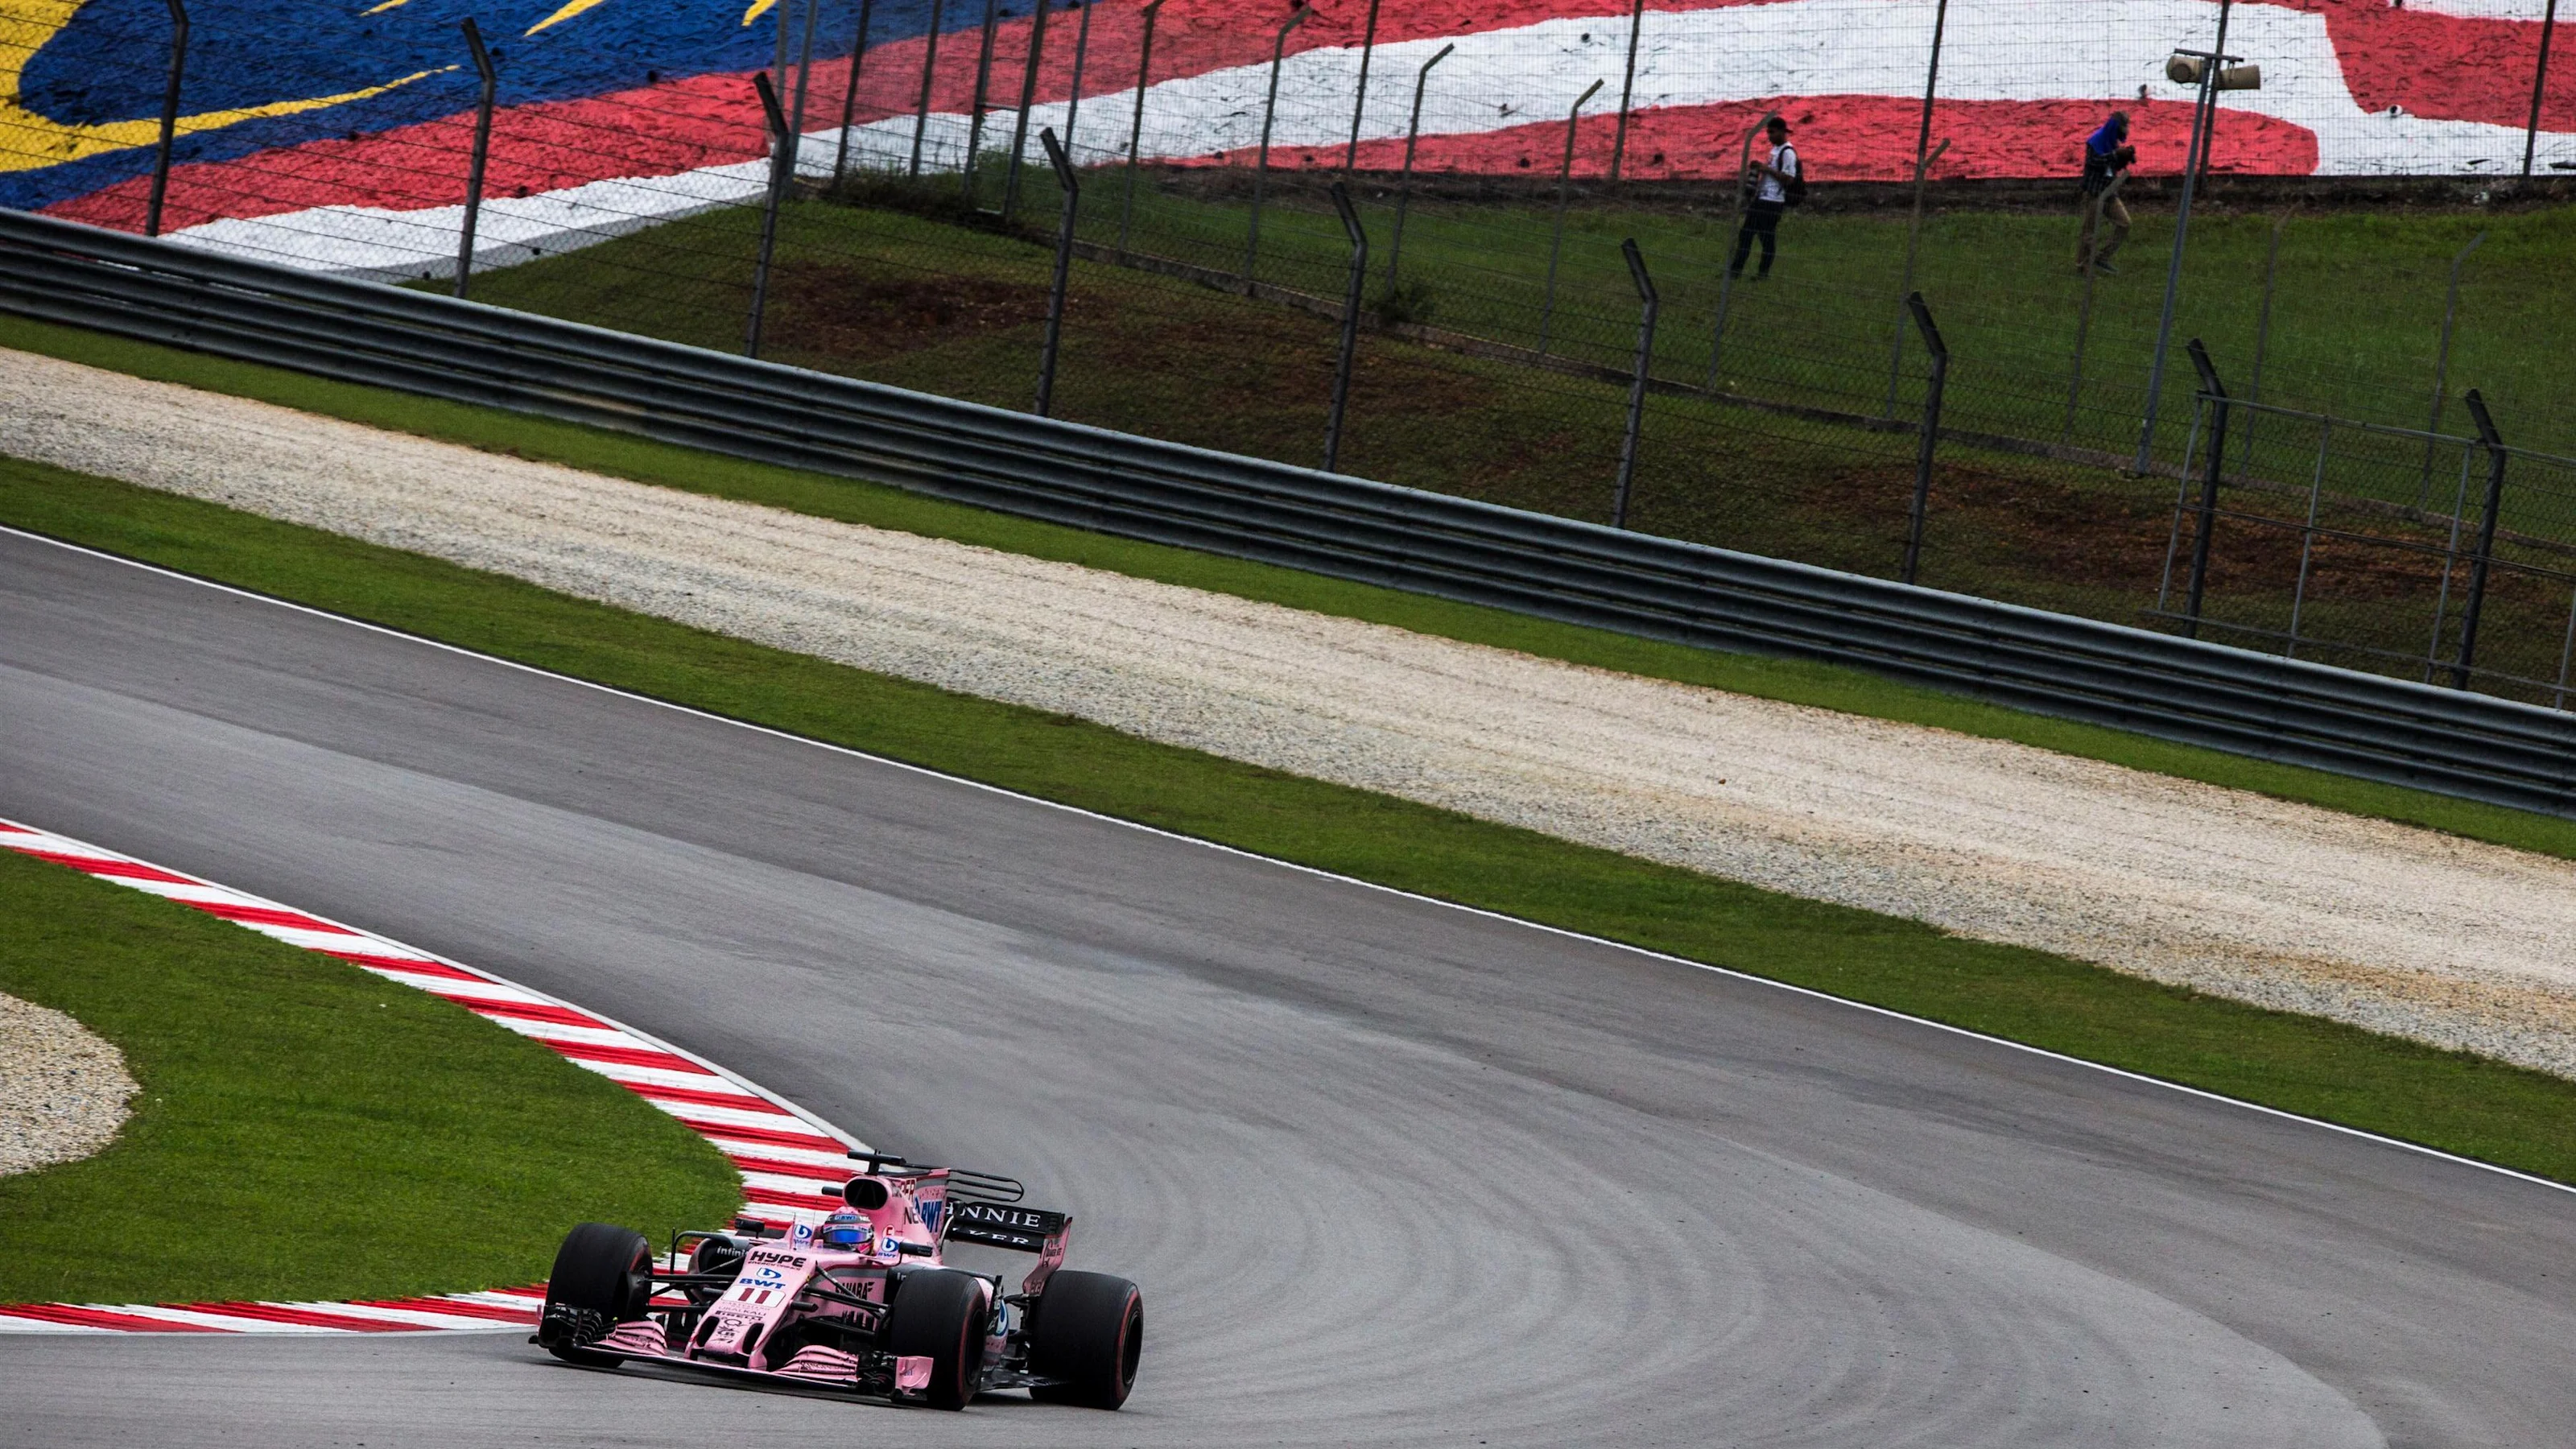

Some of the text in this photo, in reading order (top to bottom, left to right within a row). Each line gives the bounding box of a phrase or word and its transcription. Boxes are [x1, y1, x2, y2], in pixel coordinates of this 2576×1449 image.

[749, 1251, 807, 1268] HYPE
[739, 1278, 786, 1290] BWT
[737, 1287, 771, 1304] 11
